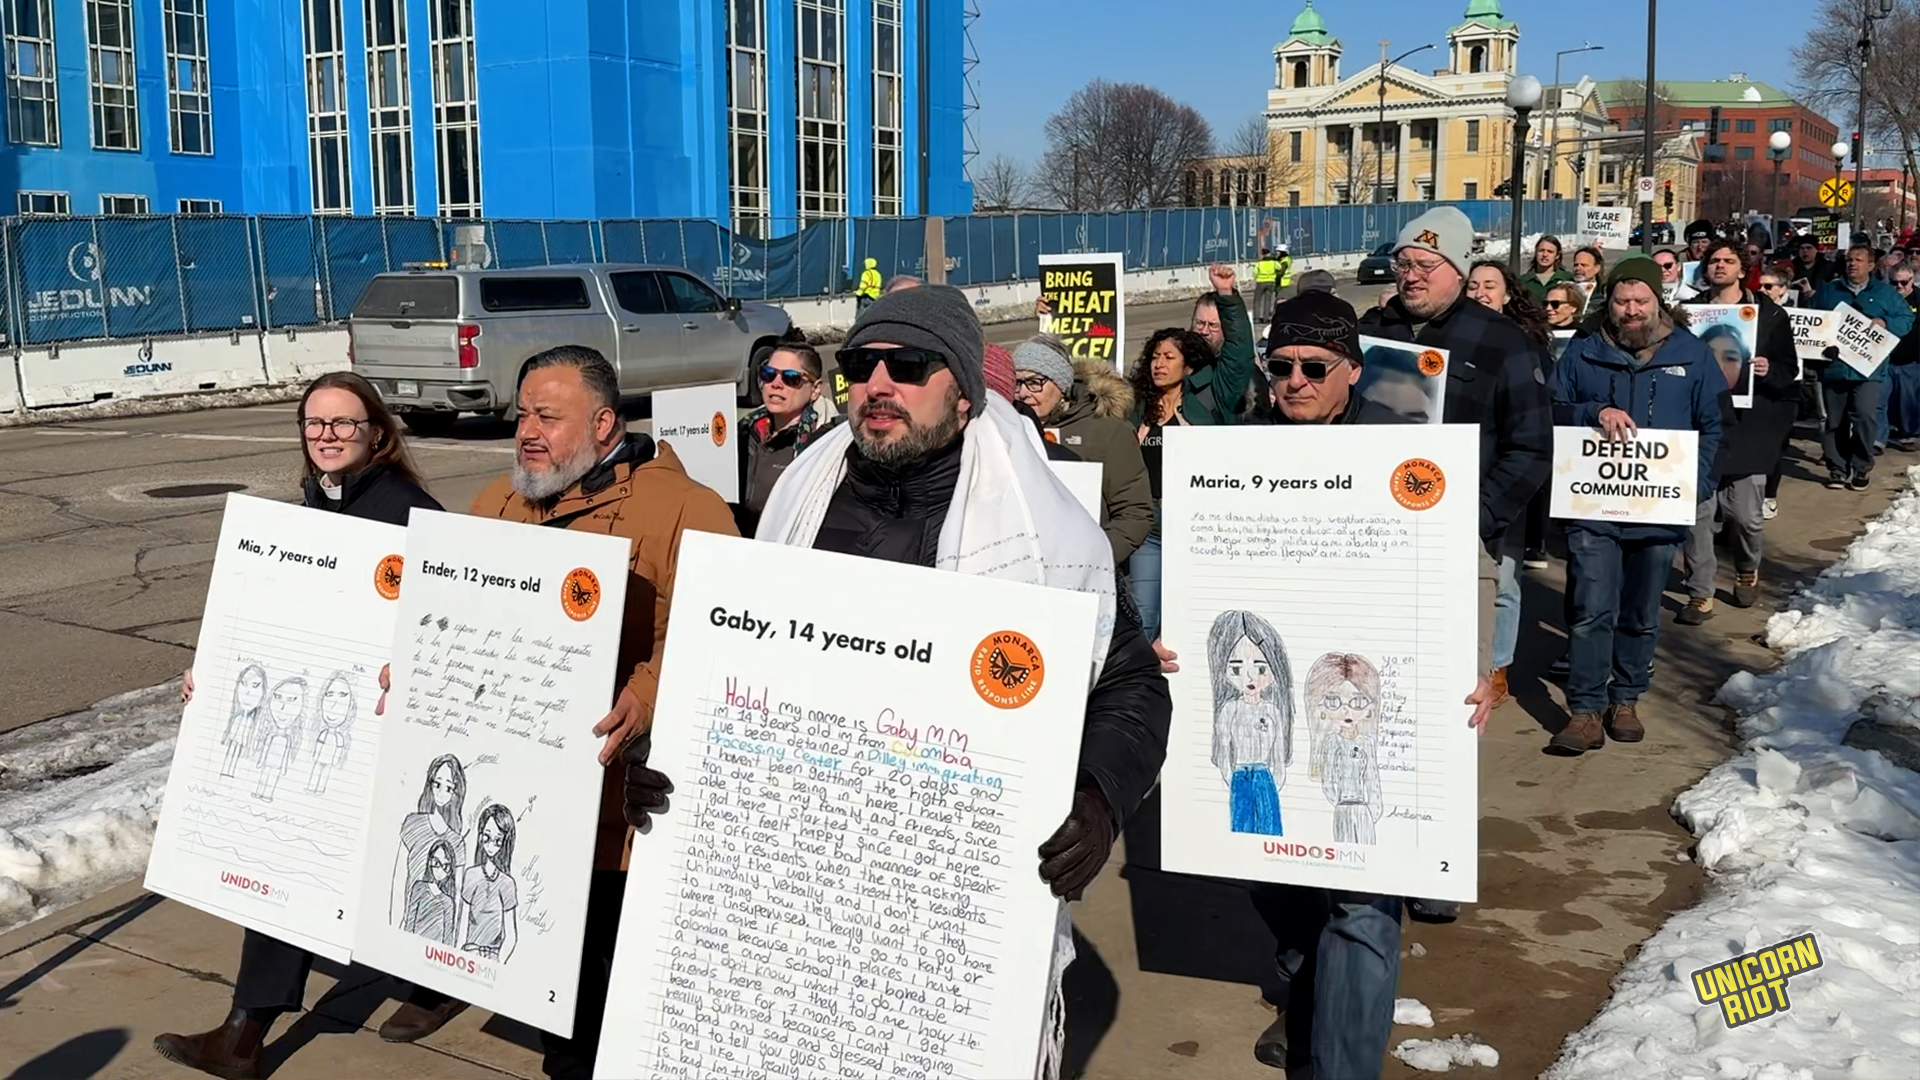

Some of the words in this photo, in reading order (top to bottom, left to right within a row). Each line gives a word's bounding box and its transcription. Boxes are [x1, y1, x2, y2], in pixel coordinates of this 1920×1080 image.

[1587, 211, 1599, 220] WE
[1601, 213, 1620, 221] ARE
[1587, 221, 1613, 231] LIGHT.
[1045, 270, 1093, 288] BRING
[1043, 292, 1058, 301] THE
[1058, 290, 1115, 314] HEAT
[1045, 317, 1094, 334] MELT
[1789, 314, 1823, 327] FEND
[1844, 314, 1864, 330] WE
[1861, 328, 1884, 344] ARE
[1792, 327, 1810, 338] UR
[1793, 339, 1827, 348] UNITIES
[1838, 325, 1870, 350] LIGHT.
[835, 392, 849, 404] TH
[679, 426, 686, 435] 17
[686, 426, 700, 438] years
[701, 424, 709, 434] old
[1582, 439, 1669, 459] DEFEND
[1404, 461, 1442, 482] MONARCA
[1598, 462, 1649, 481] OUR
[1190, 475, 1246, 490] Maria,
[1251, 475, 1263, 489] 9
[1268, 479, 1318, 493] years
[1324, 475, 1353, 490] old
[1570, 482, 1681, 499] COMMUNITIES
[237, 538, 264, 556] Mia,
[268, 545, 277, 556] 7
[279, 549, 313, 565] years
[317, 557, 338, 570] old
[422, 560, 458, 581] Ender,
[463, 567, 478, 582] 12
[481, 572, 516, 590] years
[520, 578, 542, 593] old
[573, 570, 598, 594] MONARCA
[709, 606, 776, 639] Gaby,
[789, 619, 814, 642] 14
[821, 630, 886, 655] years
[893, 638, 932, 663] old
[974, 647, 988, 676] RAPID
[993, 635, 1040, 671] MONARCA
[978, 679, 1019, 704] RESPONSE
[1021, 680, 1038, 699] LINE
[725, 676, 769, 716] Hola!
[807, 709, 846, 728] name
[853, 719, 867, 733] is
[876, 707, 917, 751] Gaby
[736, 709, 751, 723] 14
[759, 713, 799, 733] years
[806, 723, 830, 738] old
[744, 728, 776, 742] been
[786, 734, 850, 756] detained
[853, 750, 864, 759] in
[867, 748, 905, 774] Dilley
[706, 728, 785, 762] Processing
[850, 760, 874, 776] for
[888, 769, 912, 785] 20
[919, 775, 958, 796] days
[970, 786, 1003, 802] and
[768, 757, 802, 774] been
[874, 780, 897, 798] the
[698, 774, 726, 789] able
[736, 780, 750, 795] to
[788, 794, 810, 811] my
[818, 796, 862, 824] family
[870, 812, 896, 827] and
[730, 767, 754, 783] due
[765, 772, 779, 787] to
[792, 777, 827, 801] being
[837, 791, 849, 801] in
[971, 814, 1000, 835] been
[709, 791, 728, 806] got
[736, 795, 766, 813] here
[862, 823, 878, 836] to
[887, 829, 917, 846] feel
[963, 848, 1000, 865] also
[1440, 861, 1450, 872] 2
[337, 909, 344, 920] 2
[548, 990, 556, 1002] 2
